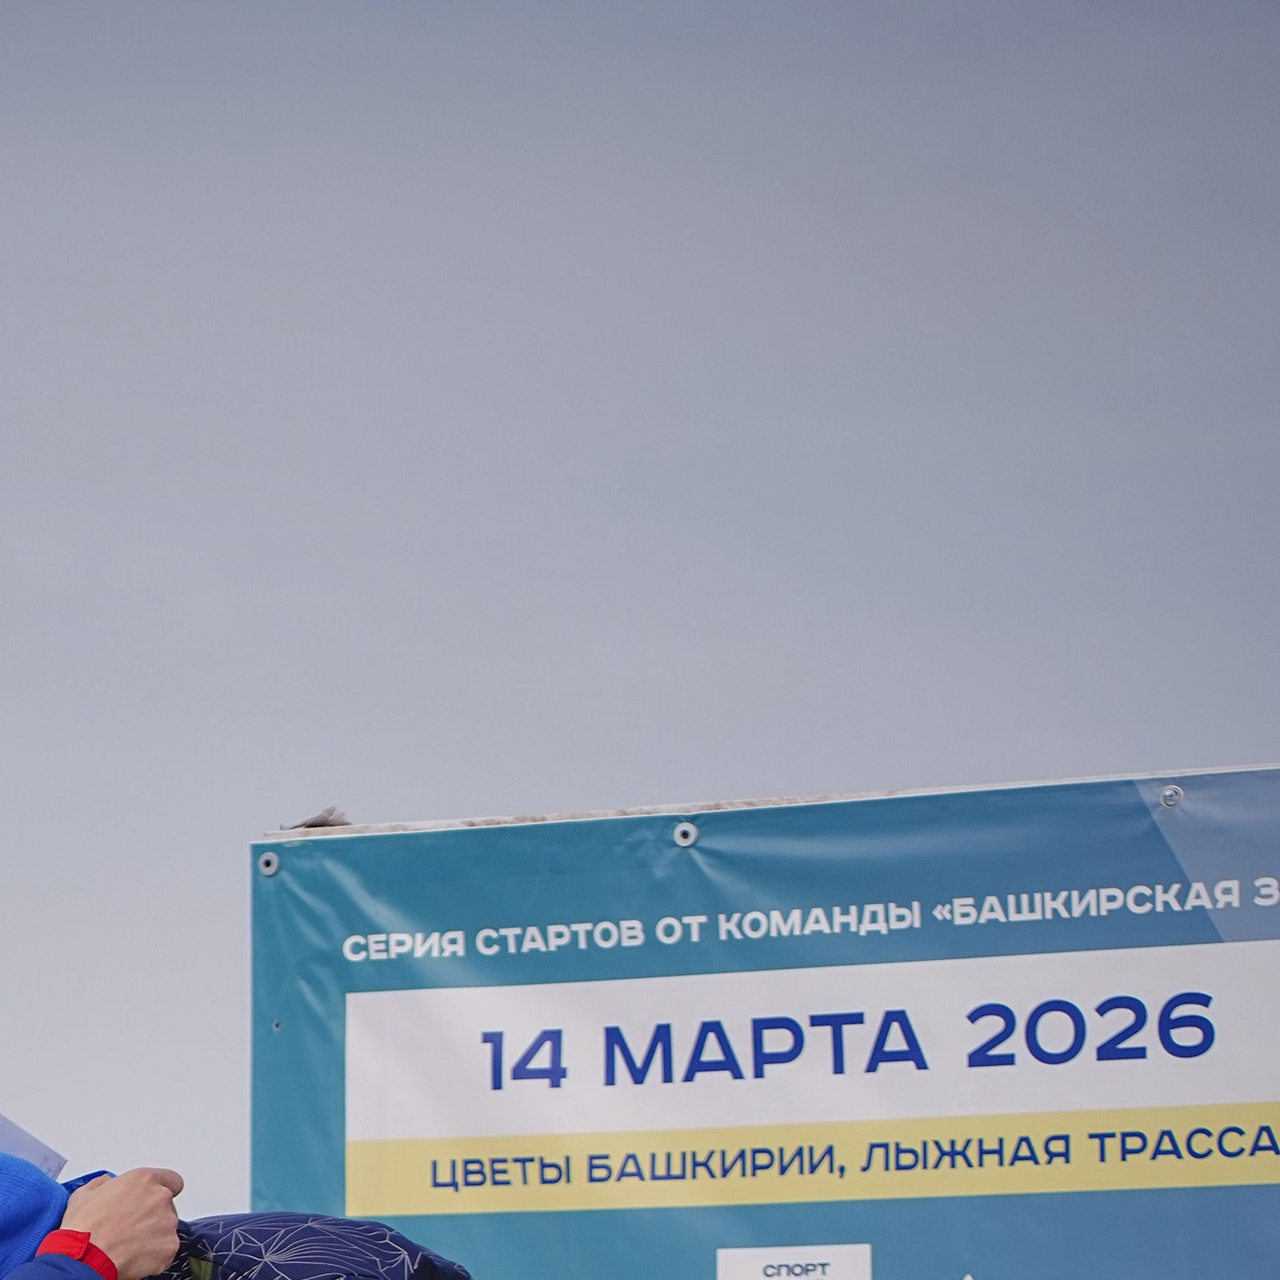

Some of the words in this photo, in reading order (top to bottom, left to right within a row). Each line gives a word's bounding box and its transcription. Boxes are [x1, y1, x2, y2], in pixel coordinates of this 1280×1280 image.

[342, 930, 465, 962] СЕРИЯ
[475, 919, 645, 956] СТАРТОВ
[656, 915, 708, 946] ОТ
[719, 901, 921, 937] КОМАНДЫ
[931, 880, 1240, 926] «БАШКИРСКАЯ
[481, 1029, 568, 1091] 14
[603, 1009, 930, 1086] МАРТА
[966, 992, 1216, 1069] 2026
[431, 1155, 571, 1193] ЦВЕТЫ
[587, 1144, 846, 1184] БАШКИРИИ,
[860, 1133, 1070, 1173] ЛЫЖНАЯ
[1087, 1124, 1280, 1163] ТРАССА
[762, 1262, 830, 1279] СПОРТ
